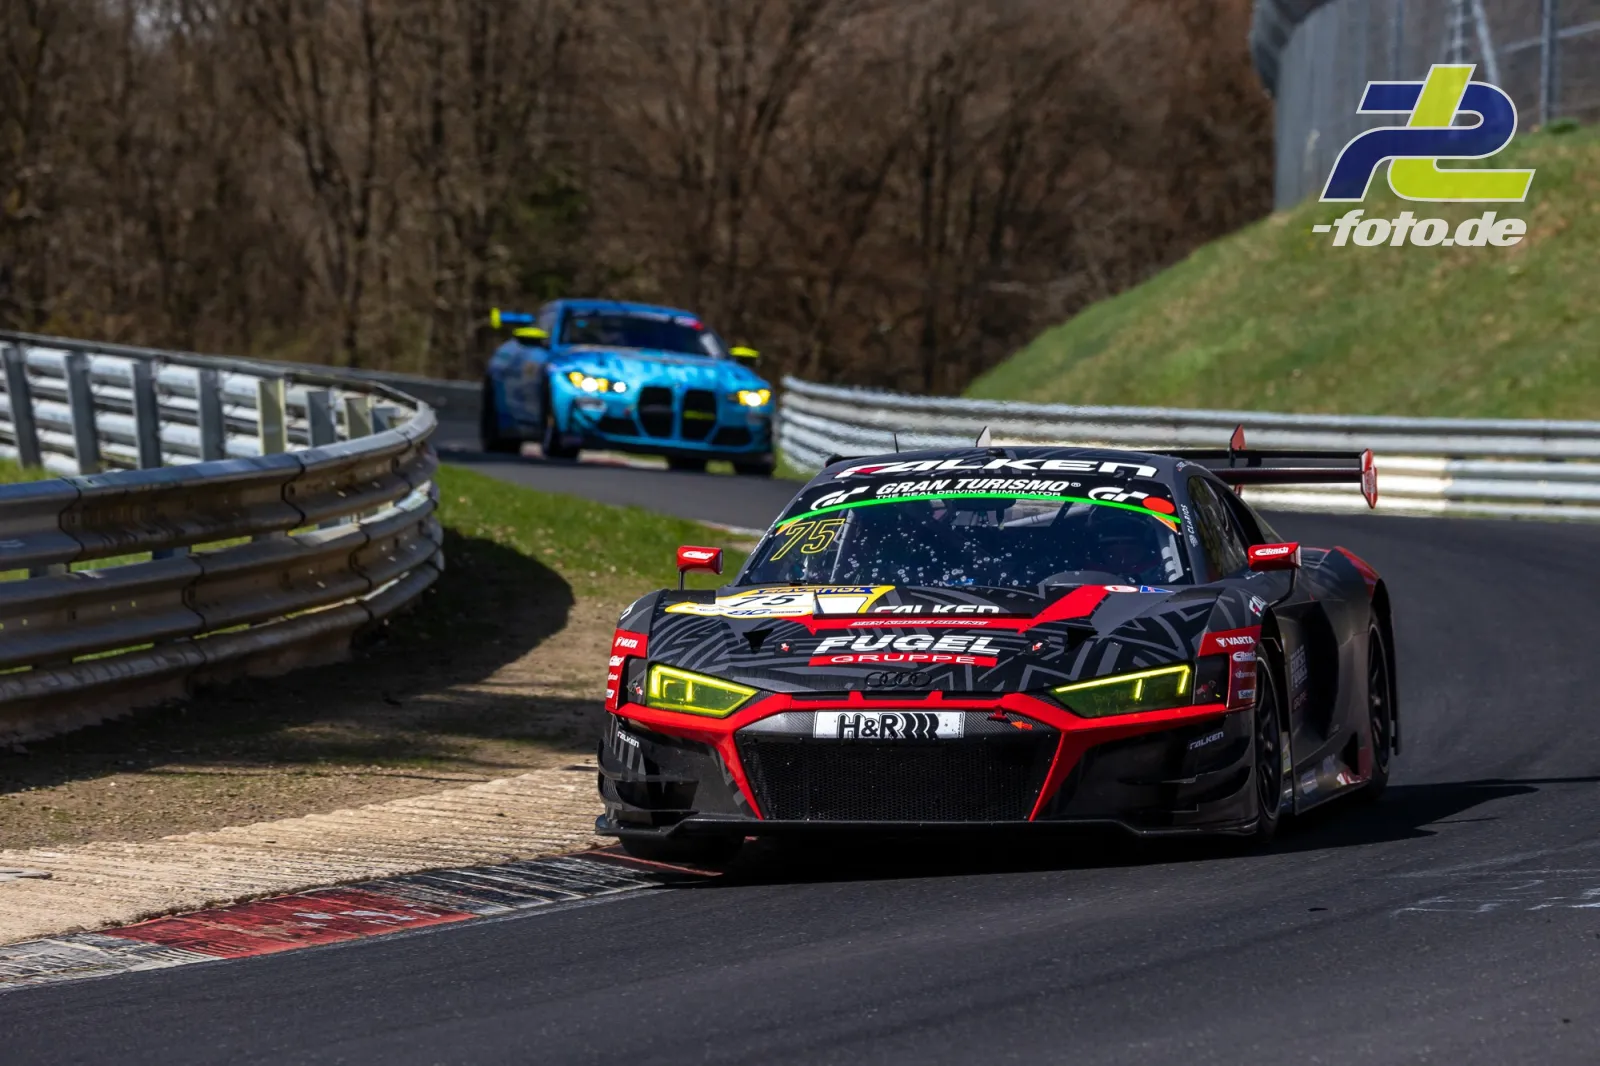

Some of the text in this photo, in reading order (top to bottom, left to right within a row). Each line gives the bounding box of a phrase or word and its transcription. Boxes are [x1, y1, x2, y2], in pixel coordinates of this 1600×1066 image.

[834, 458, 1158, 479] FALKEN
[875, 479, 952, 495] GRAN
[989, 489, 1061, 497] SIMULATOR
[1180, 504, 1196, 535] CLARIOS
[770, 518, 845, 561] 75
[731, 594, 804, 607] 75
[812, 634, 1001, 655] FUGEL
[1226, 636, 1256, 646] VARTA
[830, 654, 976, 664] GRUPPE
[617, 731, 640, 748] FALKEN
[1189, 731, 1224, 750] FALKEN
